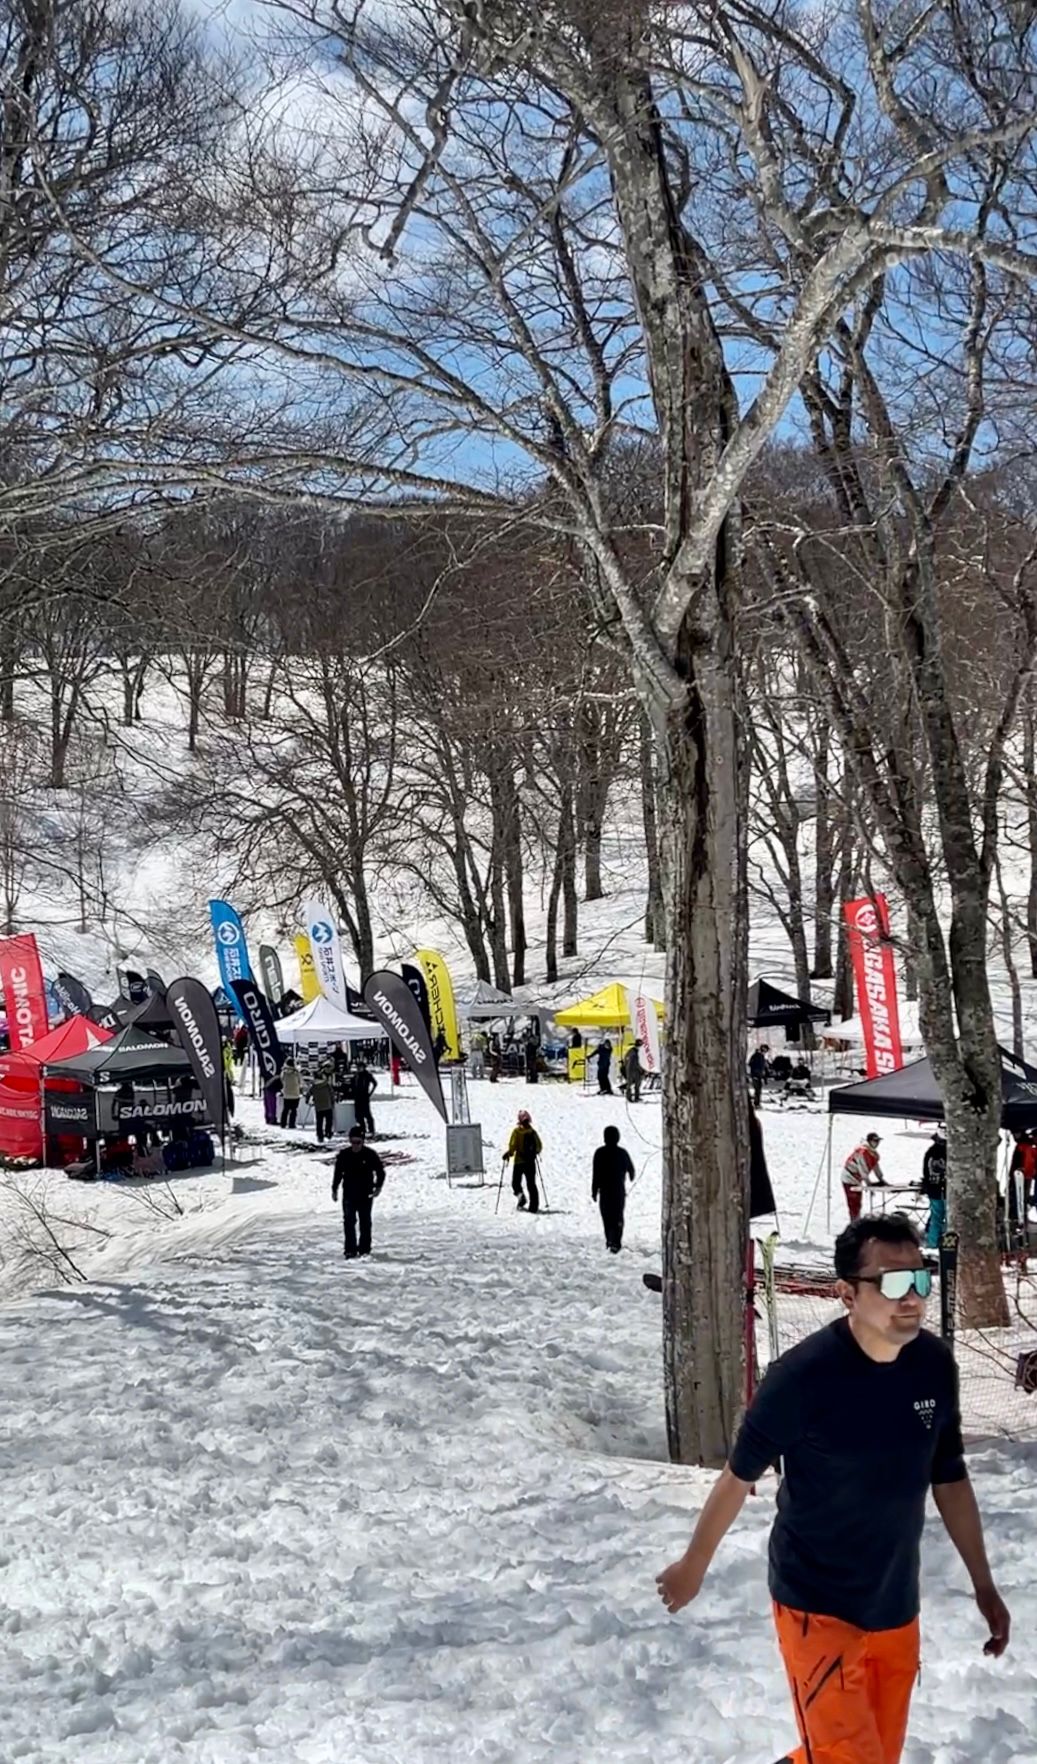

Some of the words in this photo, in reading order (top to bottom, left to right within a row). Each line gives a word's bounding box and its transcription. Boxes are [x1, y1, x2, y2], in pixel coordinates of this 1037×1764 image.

[118, 1042, 168, 1052] SALOMON
[500, 1043, 526, 1056] EAD
[99, 1071, 110, 1082] S
[119, 1099, 208, 1119] SALOMON
[913, 1398, 936, 1411] GIRO
